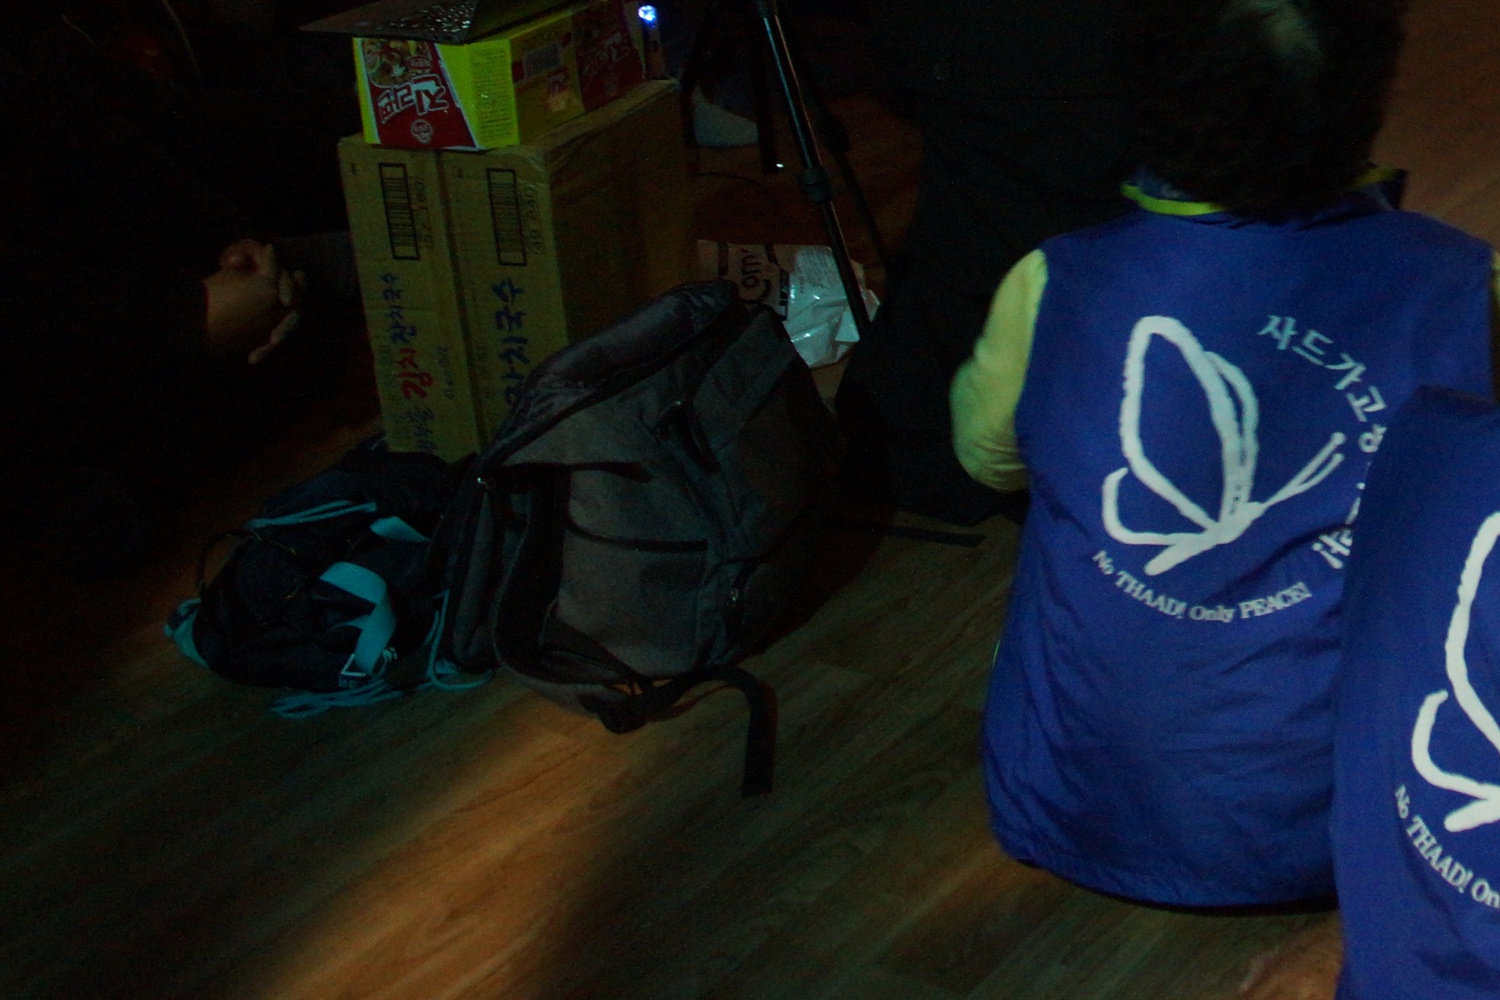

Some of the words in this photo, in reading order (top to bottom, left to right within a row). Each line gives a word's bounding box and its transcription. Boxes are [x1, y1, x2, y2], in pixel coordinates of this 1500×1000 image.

[1091, 550, 1115, 576] No
[1114, 570, 1186, 619] THAAD!
[1189, 604, 1236, 623] Only
[1394, 784, 1411, 820] No
[1405, 815, 1474, 894] THAAD!
